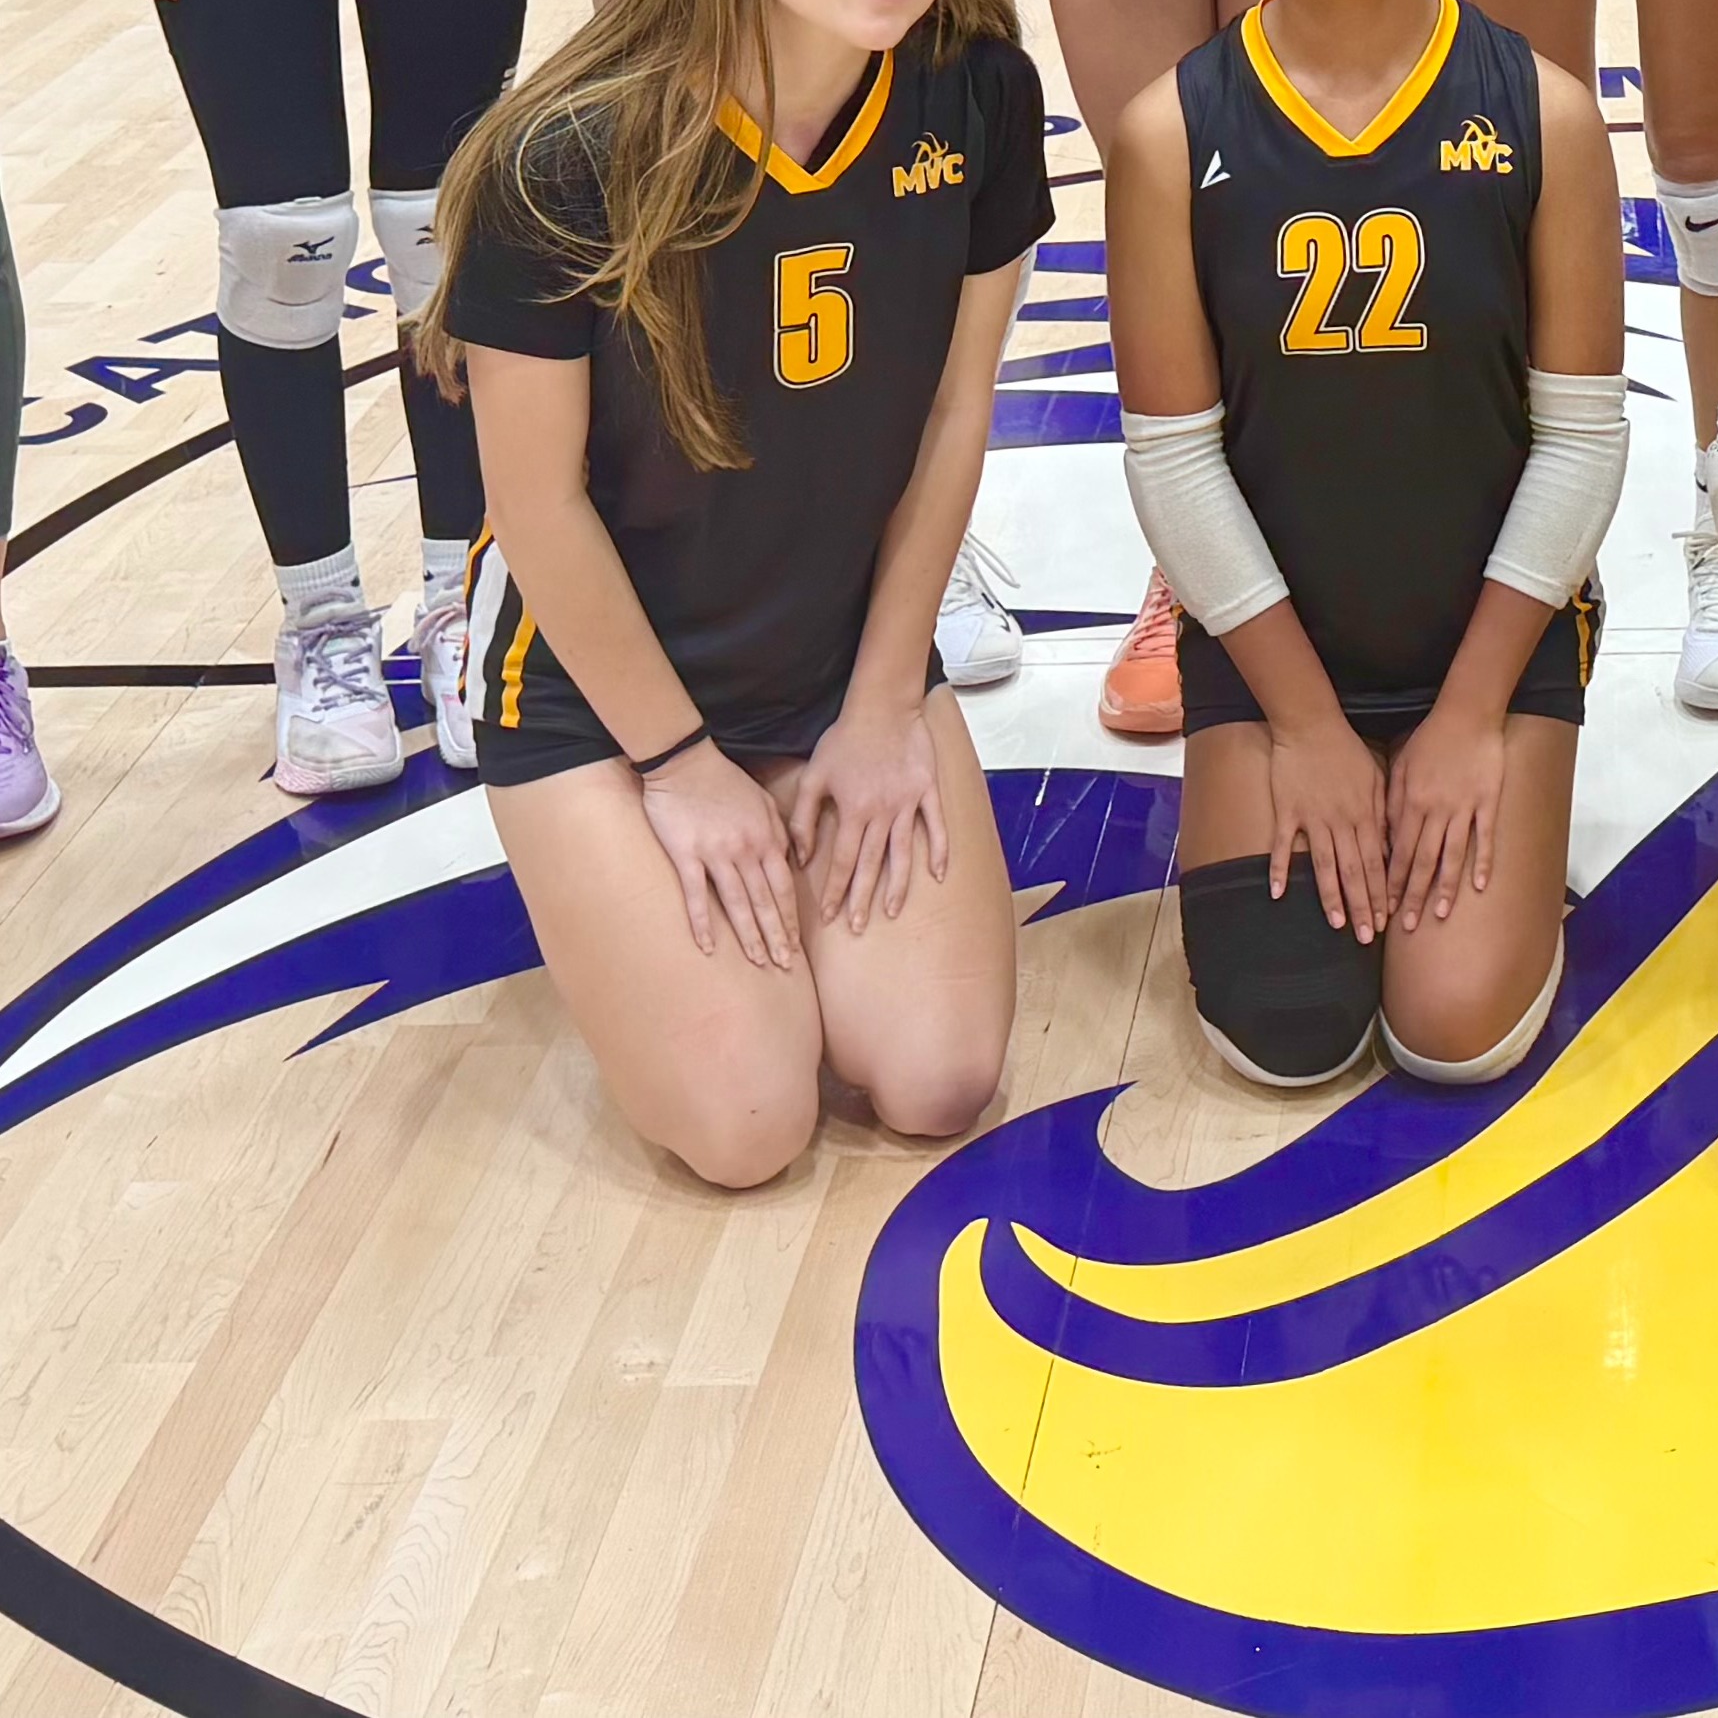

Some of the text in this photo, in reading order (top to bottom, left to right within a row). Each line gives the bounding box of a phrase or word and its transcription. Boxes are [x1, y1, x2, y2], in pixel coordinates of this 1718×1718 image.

[892, 153, 965, 198] MVC
[1440, 140, 1513, 174] MVC
[772, 242, 856, 390] 5
[1276, 206, 1428, 356] 22
